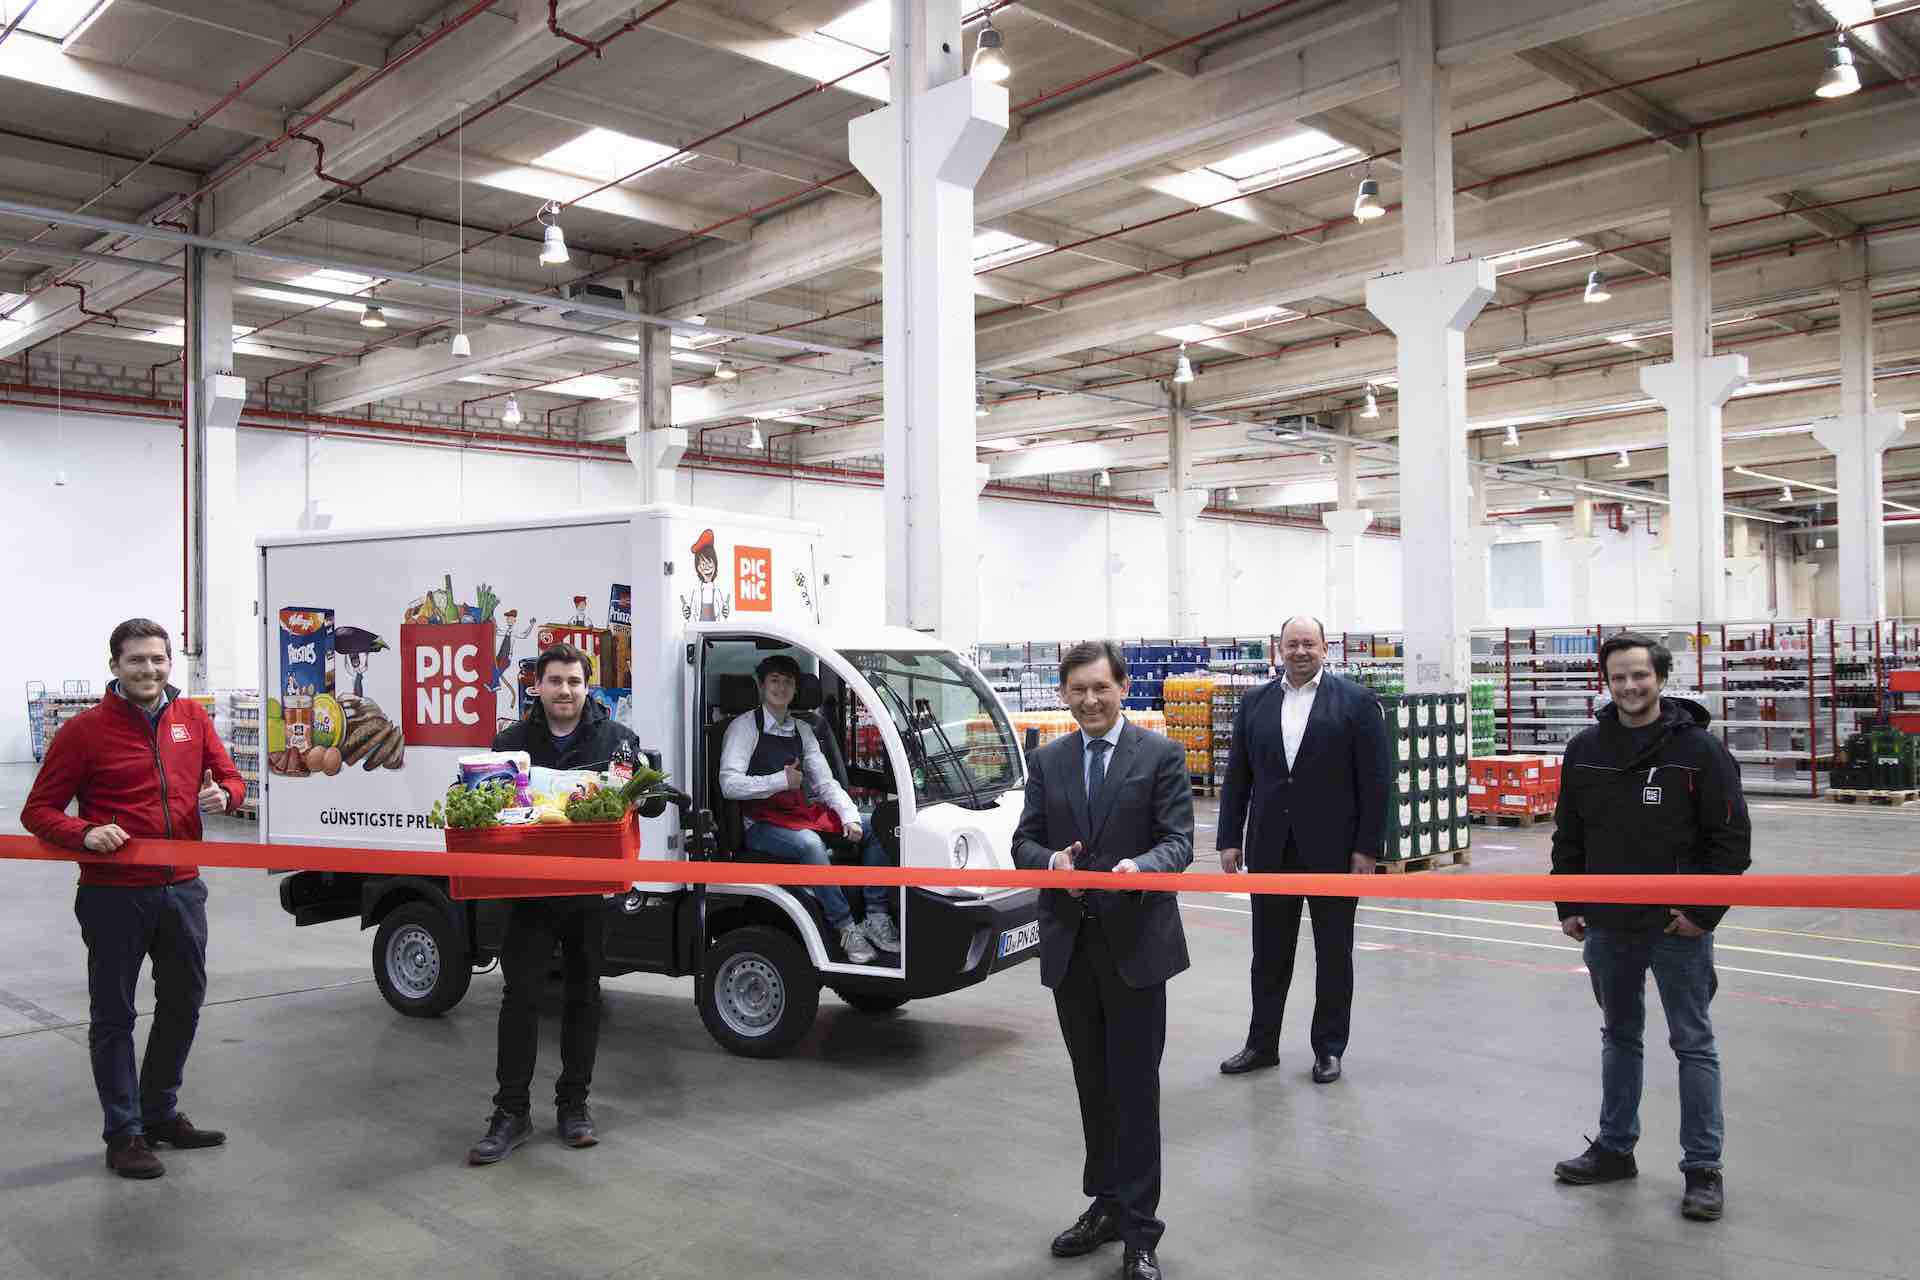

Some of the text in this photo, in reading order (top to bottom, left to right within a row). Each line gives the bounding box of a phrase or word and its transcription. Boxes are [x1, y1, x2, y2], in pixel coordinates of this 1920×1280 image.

[740, 557, 768, 578] PIC
[416, 644, 479, 683] PIC
[320, 808, 403, 828] GÜNSTIGSTE
